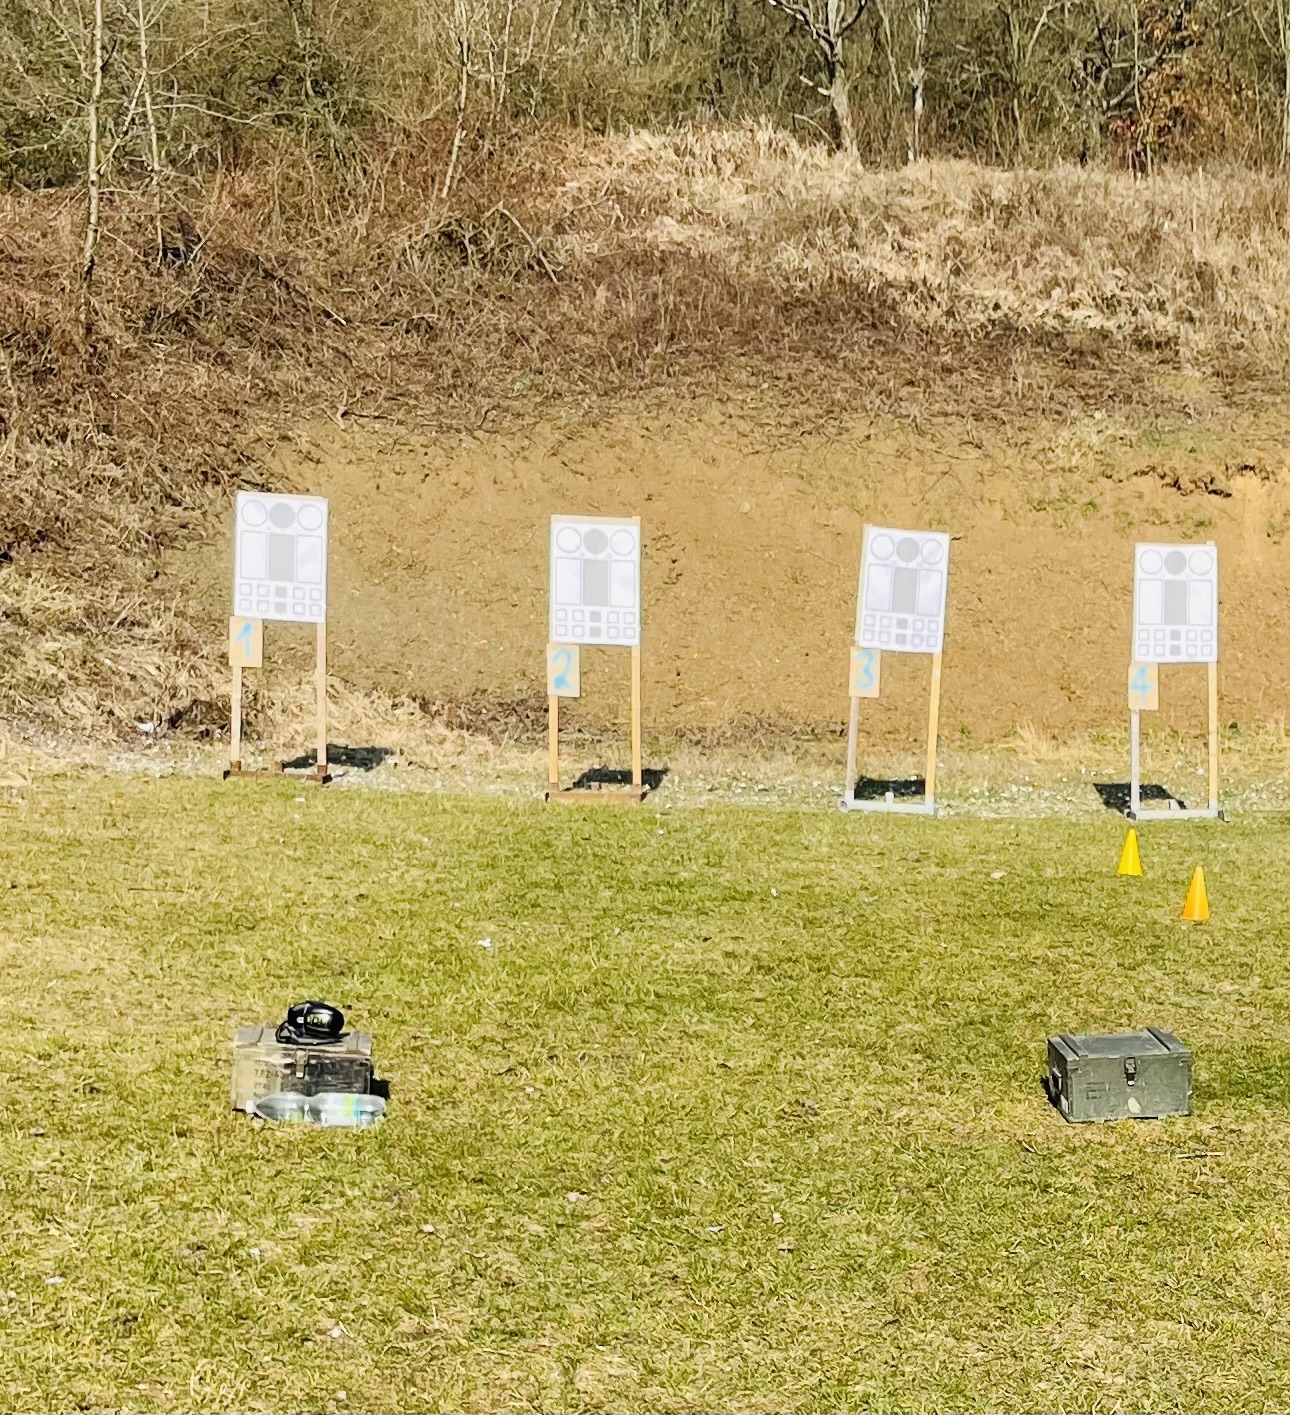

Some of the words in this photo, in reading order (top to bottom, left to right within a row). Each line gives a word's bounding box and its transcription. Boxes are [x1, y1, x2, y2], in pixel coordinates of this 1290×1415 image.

[236, 622, 252, 658] 1
[552, 648, 573, 688] 2
[854, 650, 874, 689] 3
[1131, 666, 1155, 703] 4
